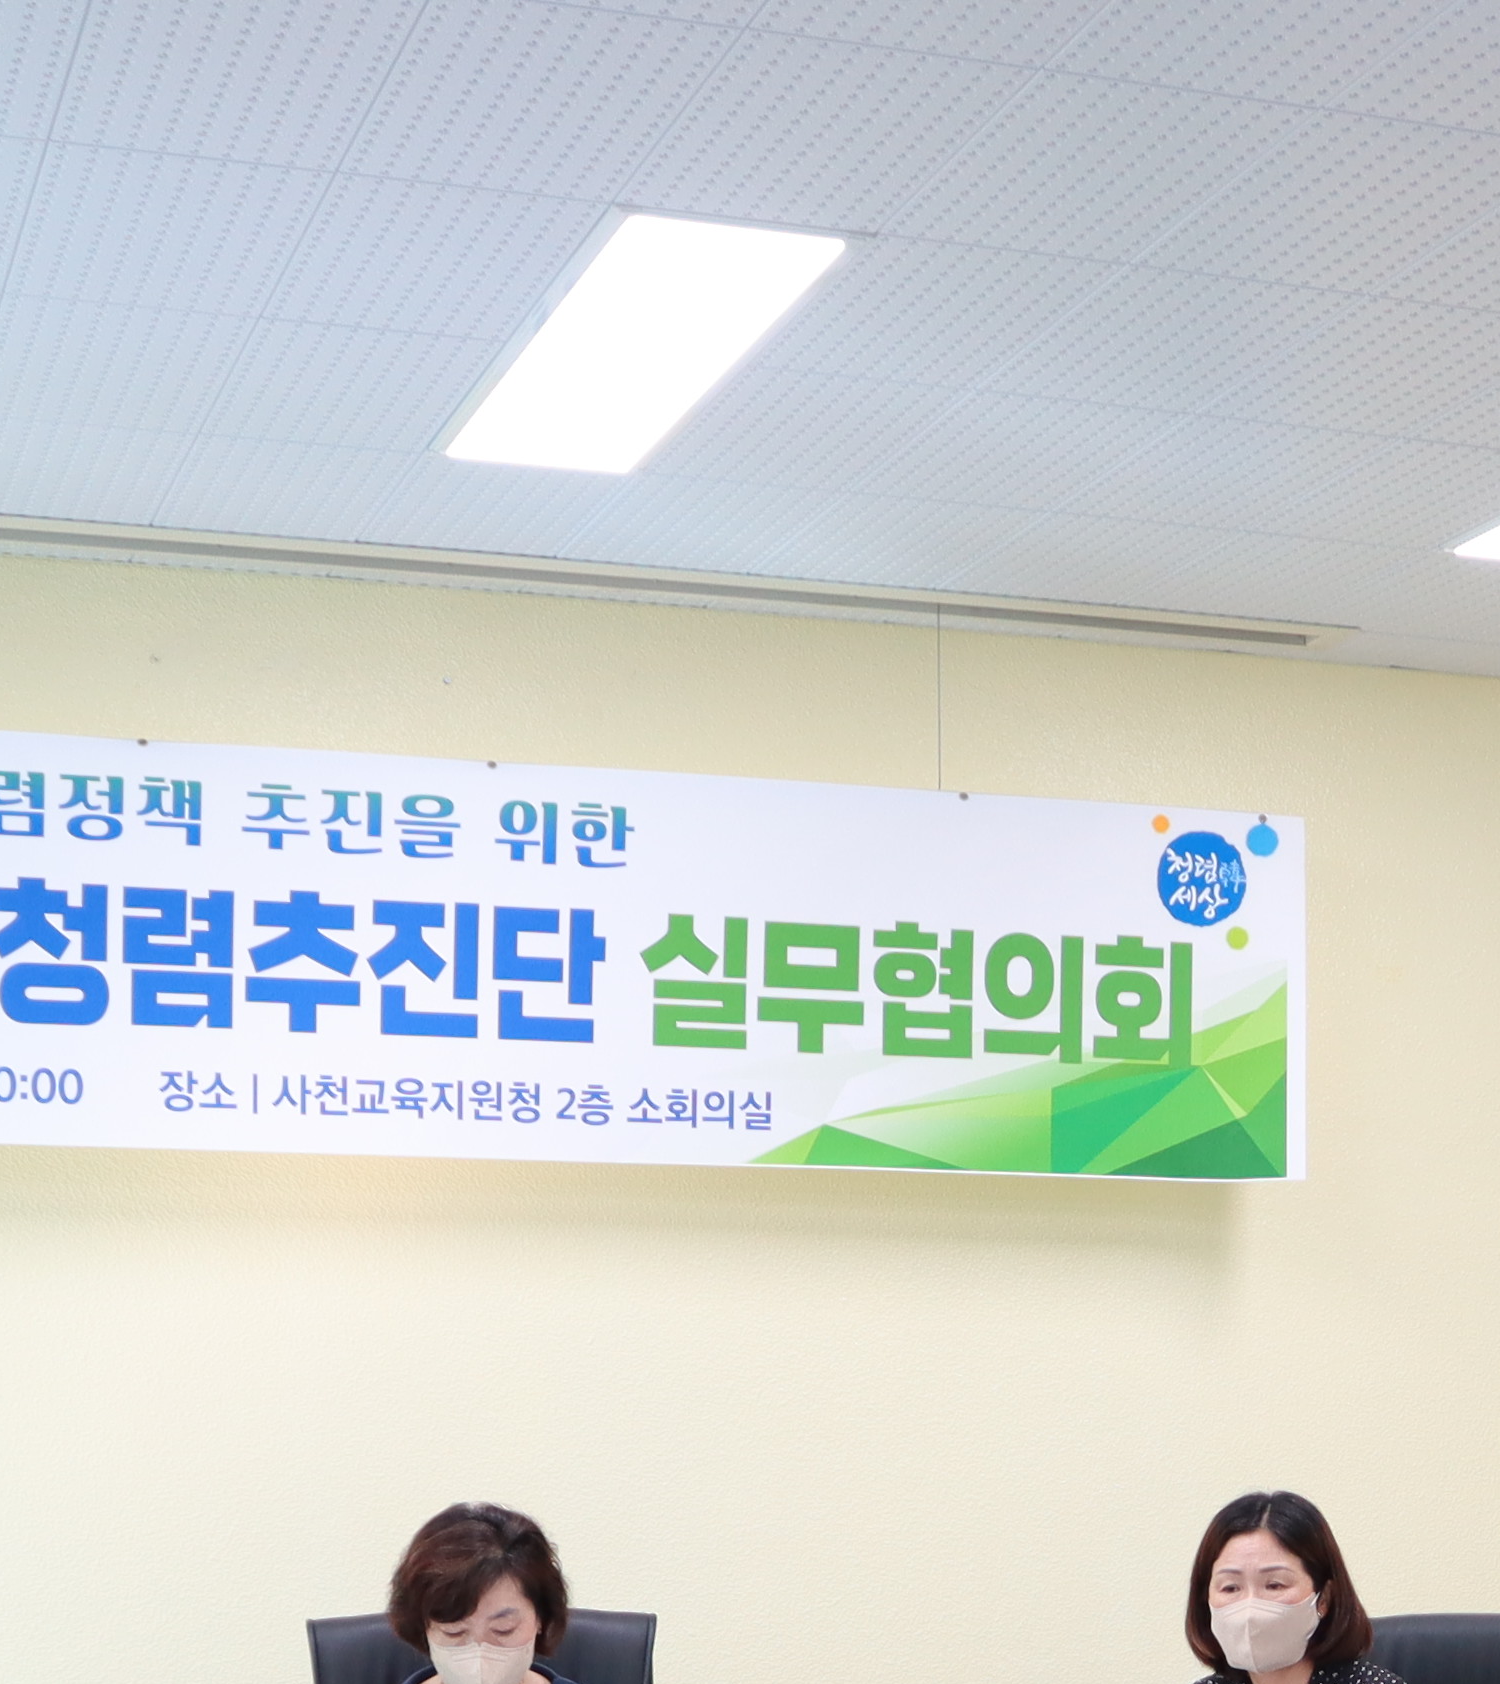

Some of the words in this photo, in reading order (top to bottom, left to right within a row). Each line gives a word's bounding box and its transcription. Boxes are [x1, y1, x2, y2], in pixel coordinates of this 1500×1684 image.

[243, 784, 461, 859] 추진을
[495, 800, 634, 868] 위한
[1166, 847, 1217, 884] 청렴
[1169, 883, 1229, 919] 세상
[640, 910, 1196, 1068] 실무협의회
[159, 1071, 237, 1112] 장소
[273, 1075, 541, 1124] 사천교육지원청
[556, 1084, 614, 1126] 2층
[627, 1088, 772, 1131] 소회의실
